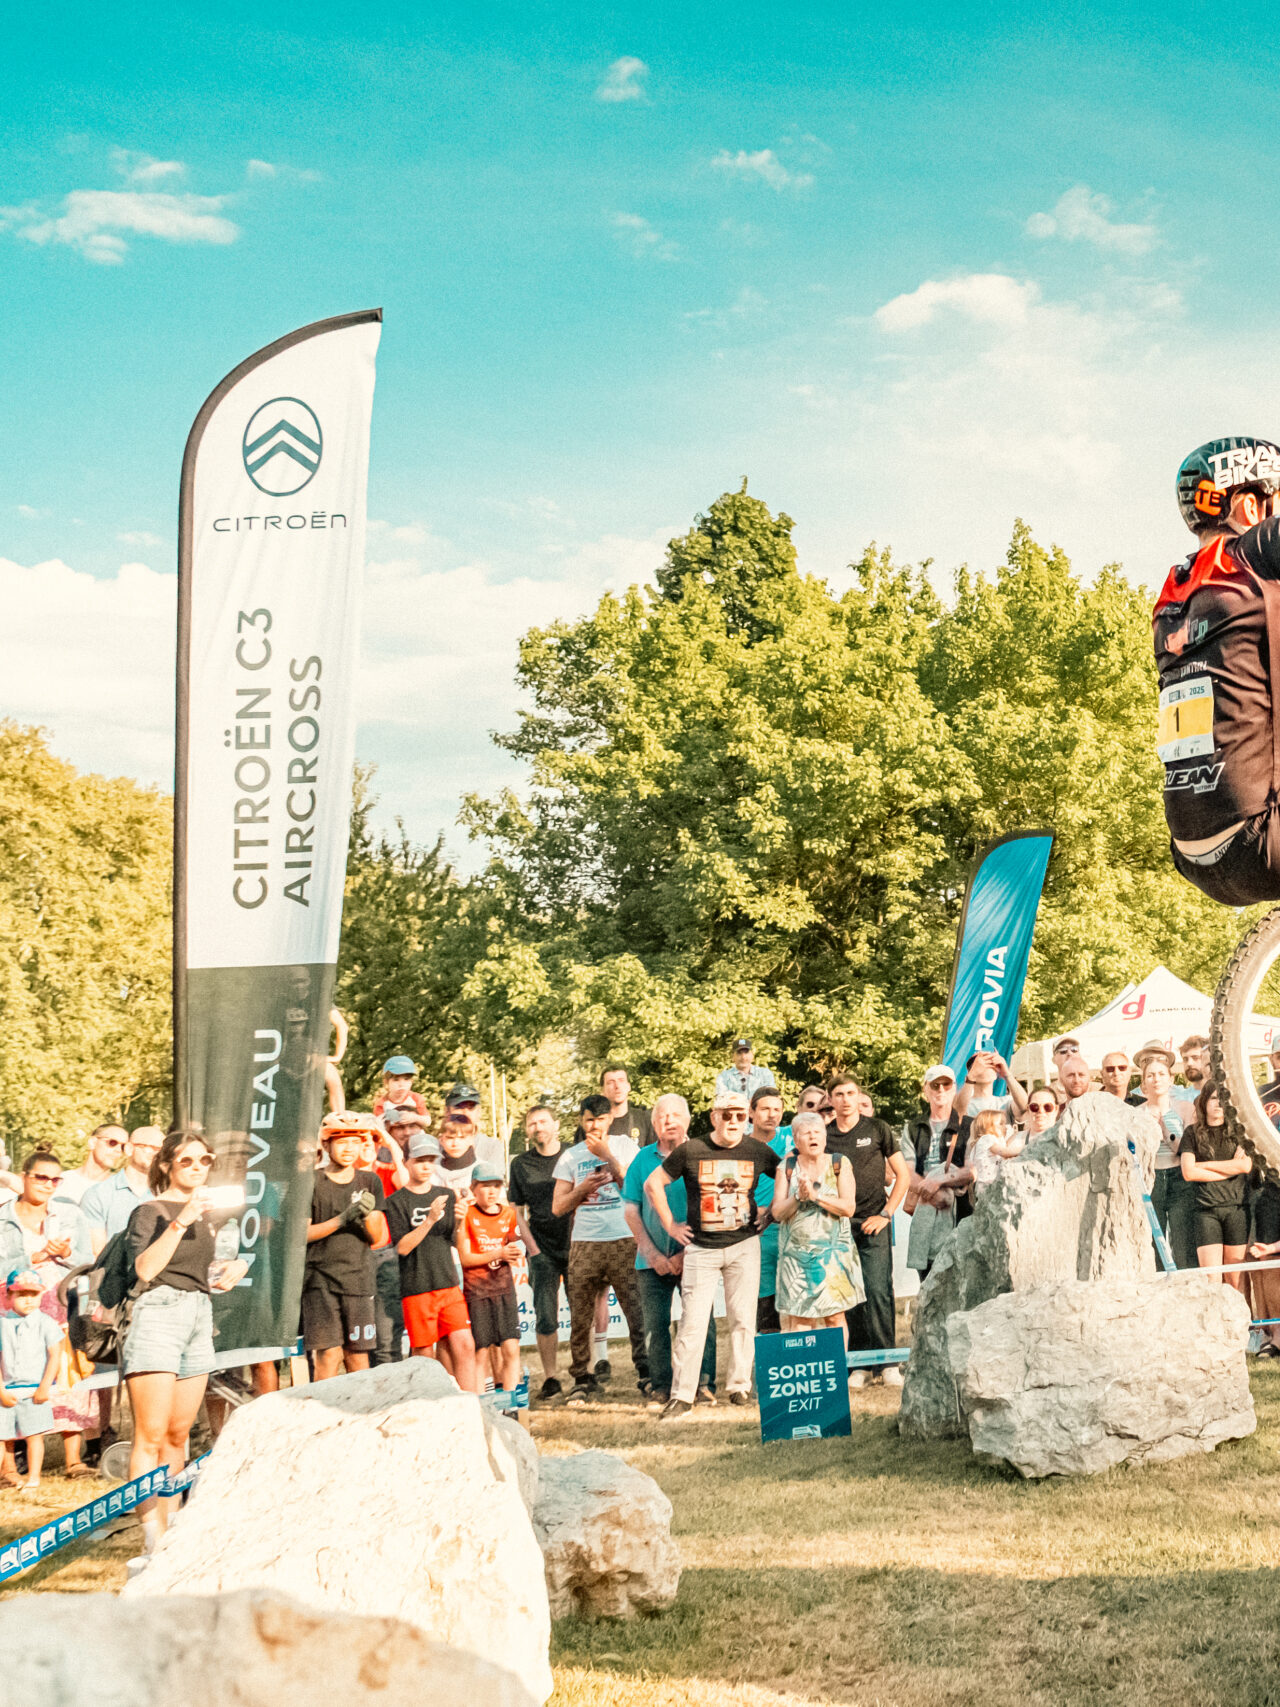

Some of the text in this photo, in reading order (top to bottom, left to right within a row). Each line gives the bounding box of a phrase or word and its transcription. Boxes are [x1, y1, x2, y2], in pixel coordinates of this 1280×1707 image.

[1208, 445, 1279, 475] TRIAL
[212, 511, 347, 532] CITROËN
[1189, 685, 1205, 696] 2025
[1173, 707, 1180, 733] 1
[224, 607, 273, 909] CITROËN C3
[283, 655, 323, 907] AIRCROSS
[768, 1360, 836, 1381] SORTIE
[769, 1377, 838, 1398] ZONE 3
[788, 1396, 824, 1413] EXIT
